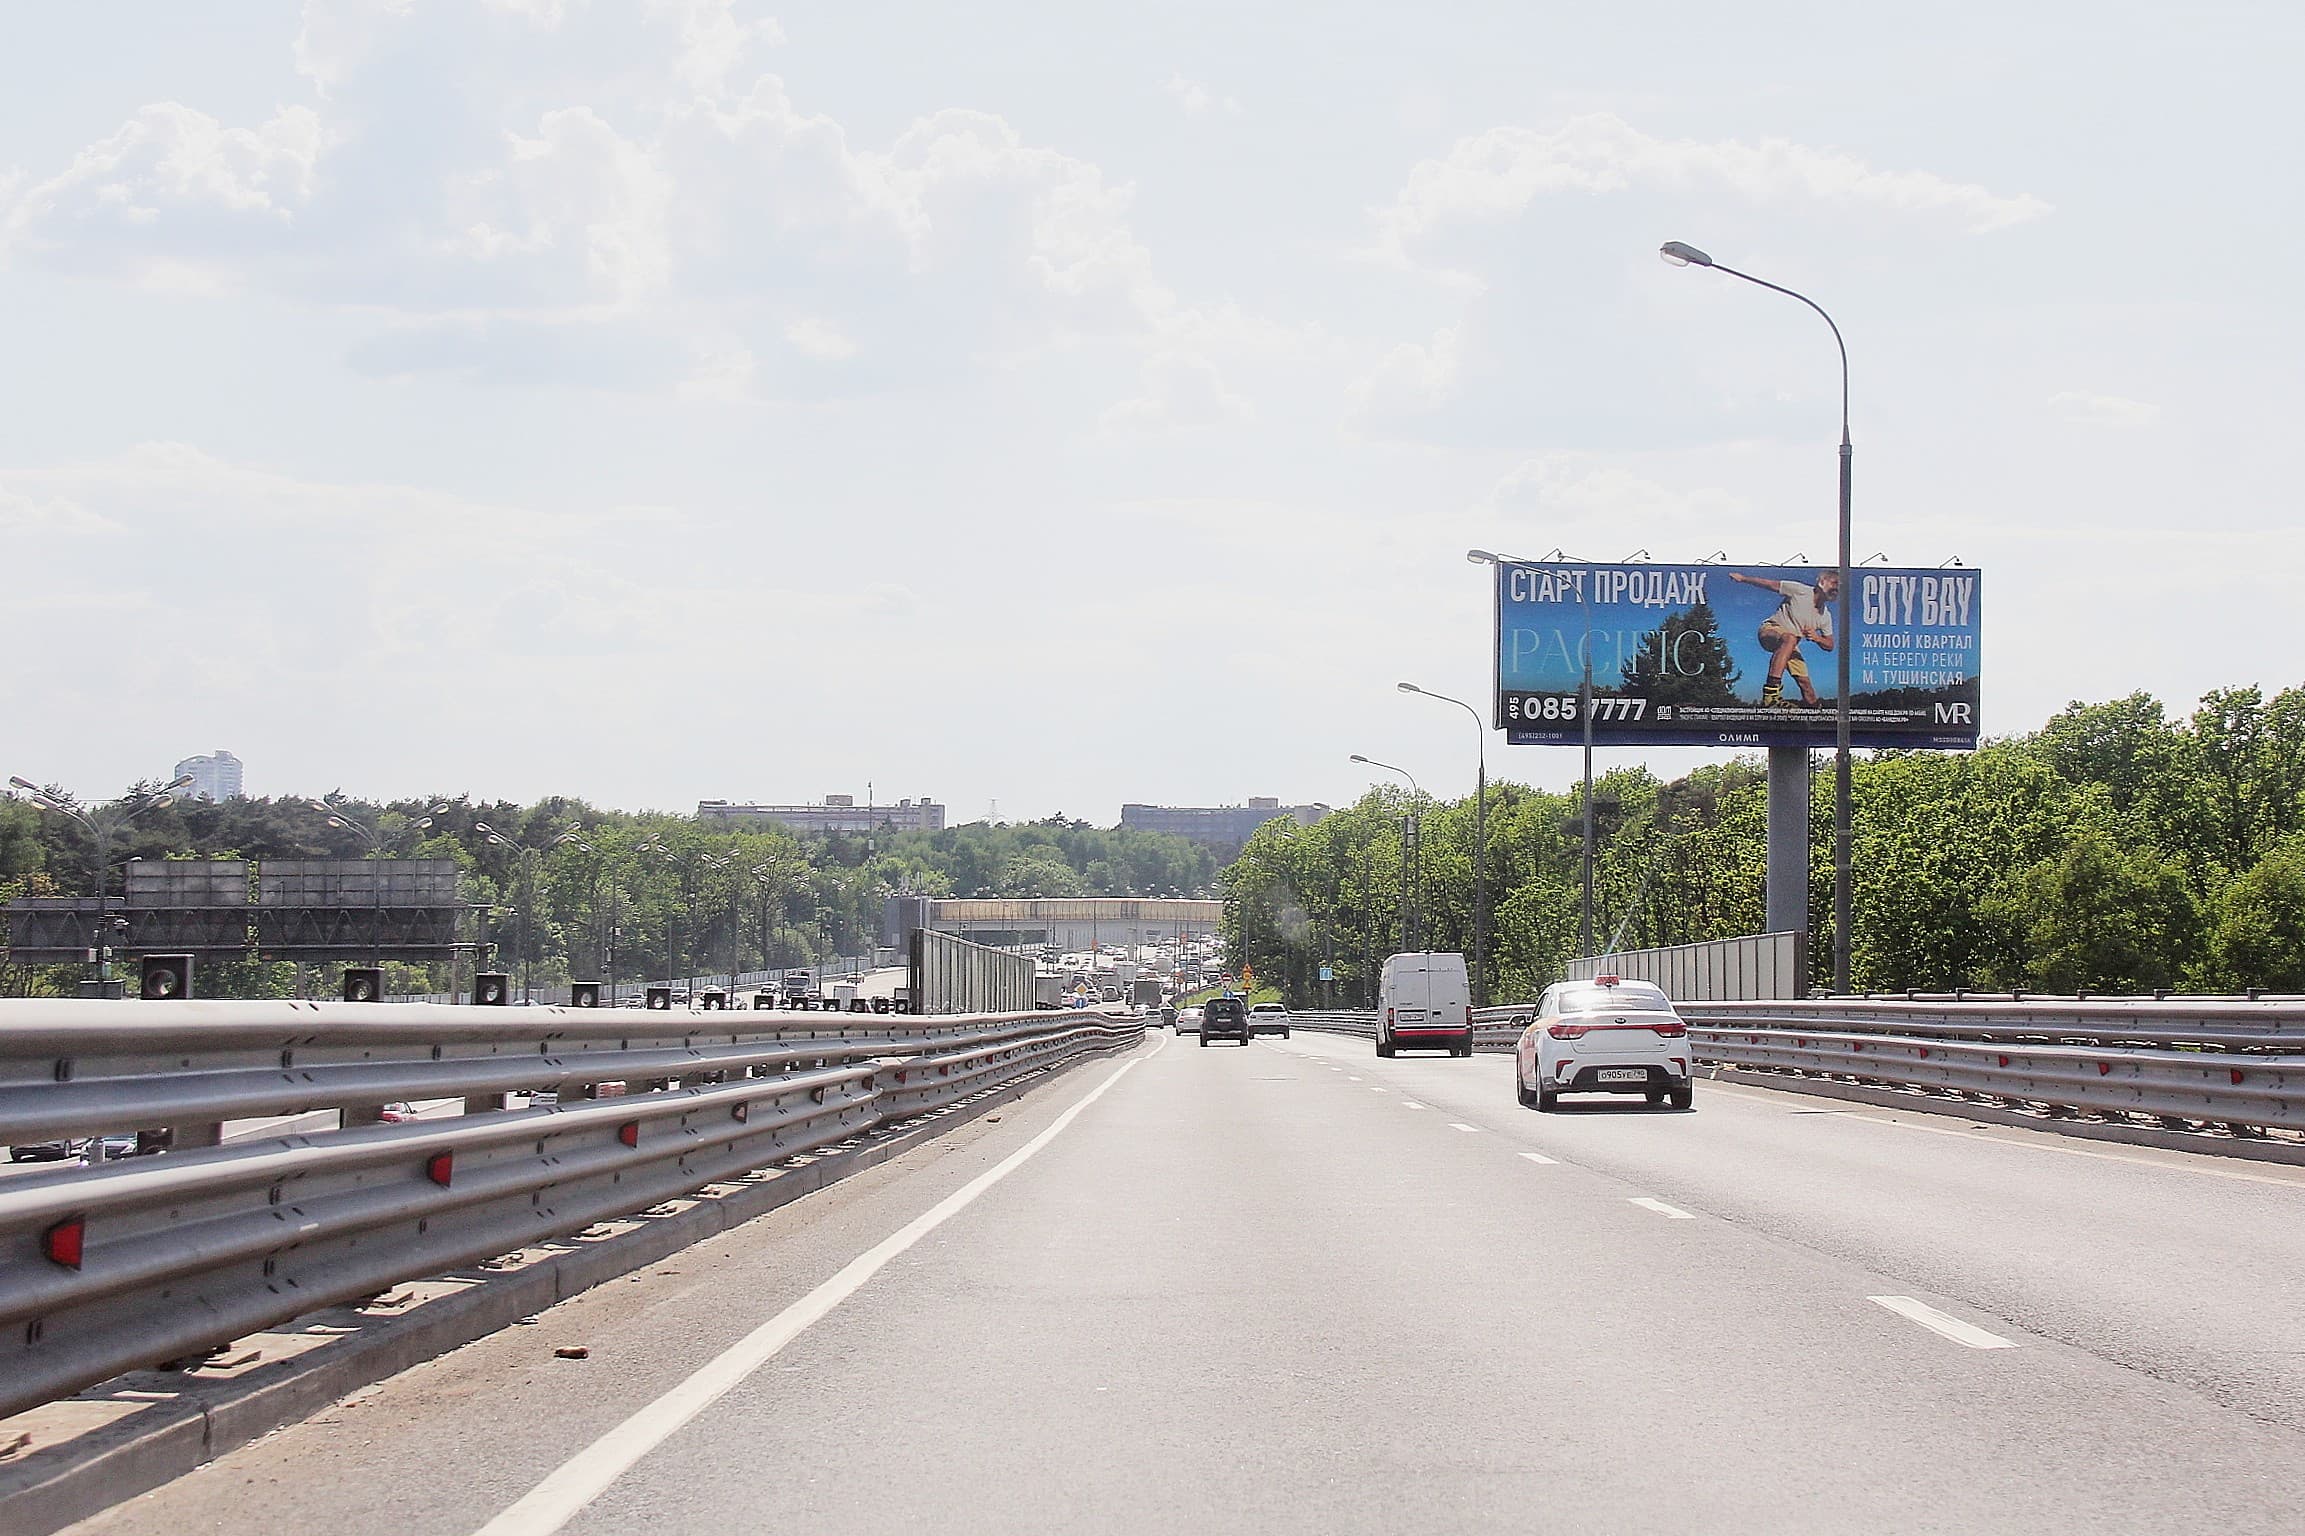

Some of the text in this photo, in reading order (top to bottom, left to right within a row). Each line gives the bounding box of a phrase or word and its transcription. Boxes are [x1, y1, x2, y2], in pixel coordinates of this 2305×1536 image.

[1510, 568, 1707, 608] СТАРТ ПРОДАЖ
[1862, 575, 1973, 626] CITY BAY
[1862, 631, 1972, 649] ЖИЛОЙ КВАРТАЛ
[1511, 628, 1706, 676] PACIFIC
[1863, 651, 1963, 667] НА БЕРЕГУ РЕКИ
[1863, 670, 1963, 685] М. ТУШИНСКАЯ
[1509, 697, 1519, 719] 495
[1523, 697, 1577, 720] 085
[1934, 702, 1972, 724] MR
[1719, 733, 1759, 742] ОЛИМП
